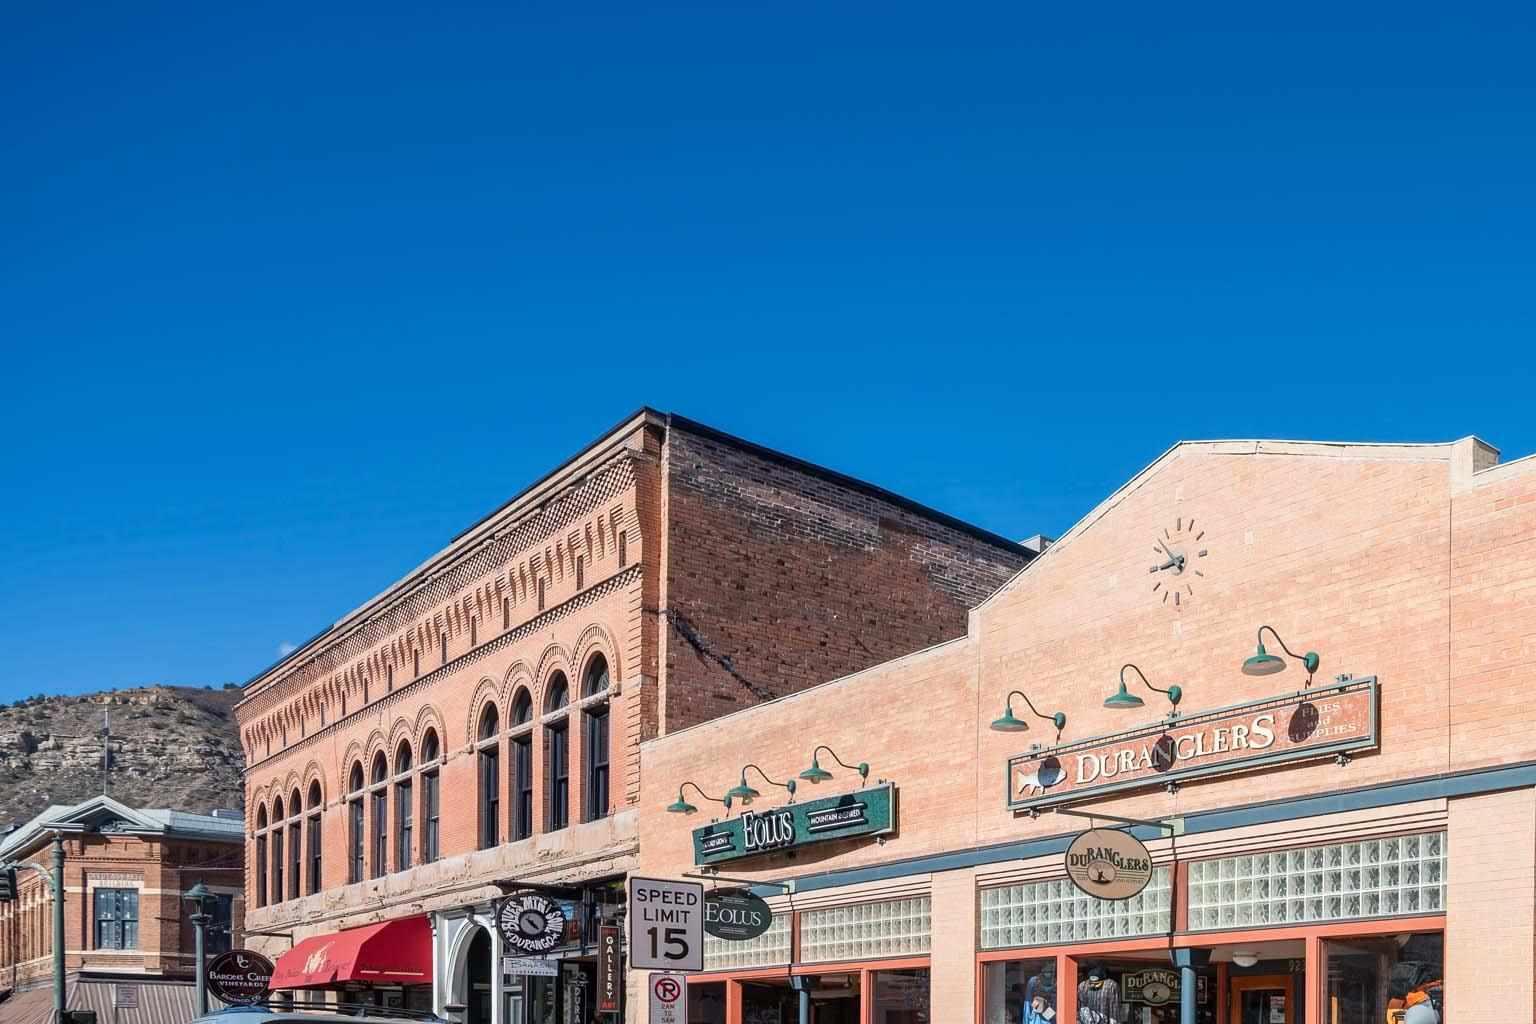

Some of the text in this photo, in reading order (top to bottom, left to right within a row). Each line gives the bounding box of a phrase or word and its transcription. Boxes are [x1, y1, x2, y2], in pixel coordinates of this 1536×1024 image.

[1076, 714, 1276, 784] DURANGLERS
[743, 812, 793, 848] EOLUS
[1070, 848, 1149, 871] DURANGLERS
[637, 889, 697, 906] SPEED
[501, 901, 524, 932] BLUES
[544, 911, 564, 933] SOUL
[644, 908, 691, 924] LIMIT
[705, 902, 761, 926] EOLUS
[509, 932, 555, 951] DURANGO
[647, 927, 690, 960] 15
[209, 971, 244, 981] BARONS
[606, 936, 615, 999] GALLERY
[218, 980, 264, 988] VINEYARDS
